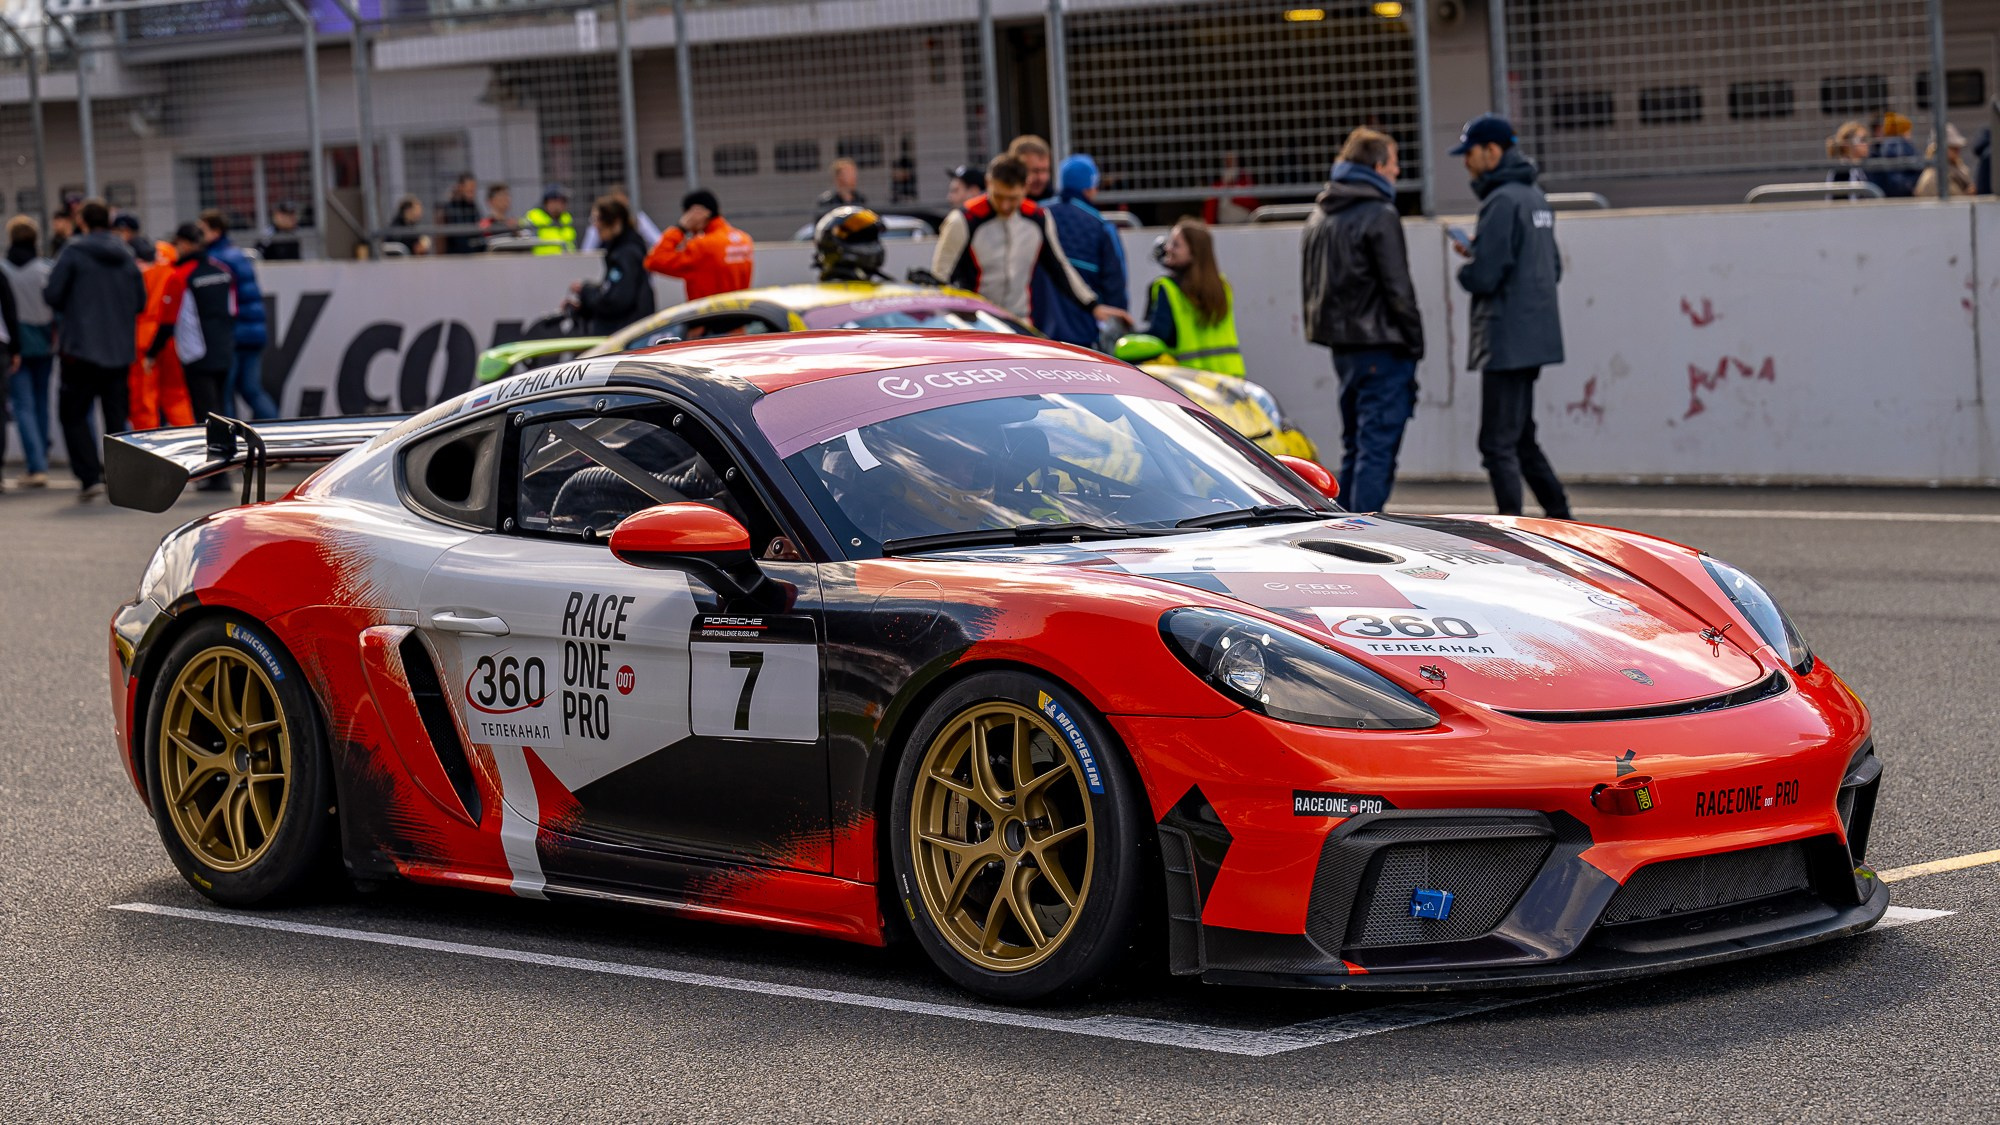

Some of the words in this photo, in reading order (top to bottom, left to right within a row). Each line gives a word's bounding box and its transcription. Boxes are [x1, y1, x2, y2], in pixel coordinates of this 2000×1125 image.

[495, 362, 591, 401] V.ZHILKIN
[923, 368, 1007, 388] СБЕР
[1009, 366, 1121, 384] Первый
[561, 591, 636, 641] RACE
[703, 617, 763, 625] PORSCHE
[1346, 614, 1479, 639] 360
[702, 629, 714, 637] SPORT
[241, 631, 281, 676] MICHELIN
[1367, 643, 1496, 654] ТЕЛЕКАНАЛ
[563, 640, 611, 690] ONE
[476, 655, 546, 708] 360
[617, 672, 634, 689] DOT
[728, 650, 764, 731] 7
[562, 690, 611, 741] PRO
[481, 722, 551, 740] ТЕЛЕКАНАЛ
[1056, 712, 1101, 786] MICHELIN
[1638, 789, 1650, 809] OMP
[1775, 779, 1800, 807] PRO
[1359, 800, 1383, 814] PRO
